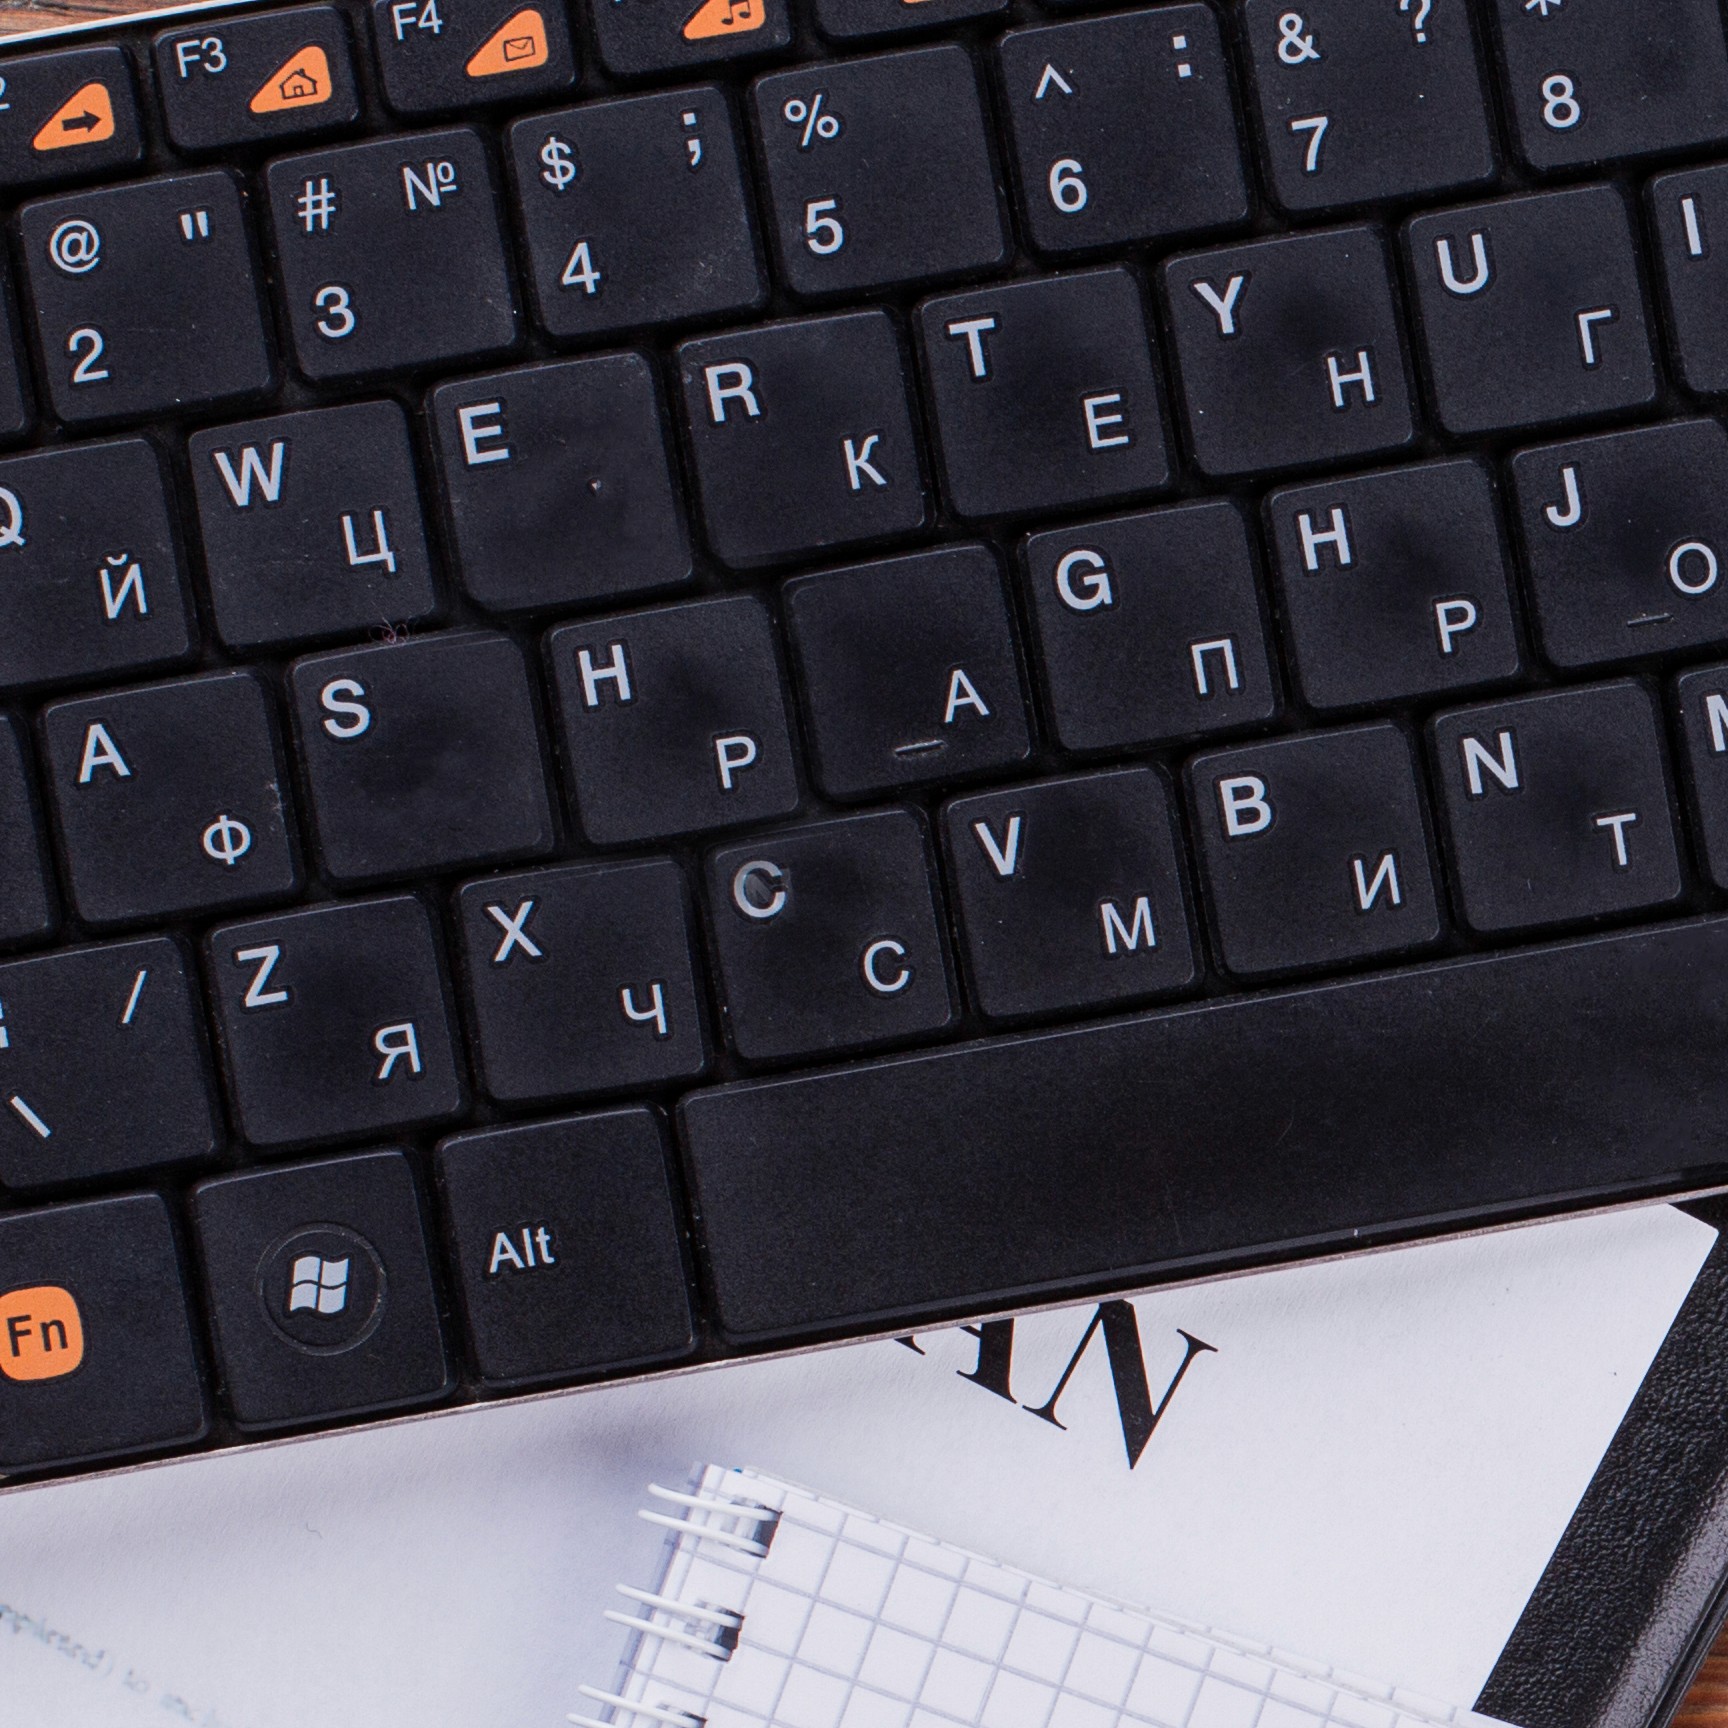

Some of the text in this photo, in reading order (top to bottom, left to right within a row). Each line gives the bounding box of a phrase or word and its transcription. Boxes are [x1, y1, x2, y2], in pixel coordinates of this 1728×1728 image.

[392, 0, 443, 41] F4
[1277, 12, 1321, 64] &
[164, 31, 227, 78] F3
[784, 94, 839, 147] %
[1542, 74, 1581, 128] 8
[541, 136, 576, 191] $
[1291, 116, 1329, 172] 7
[297, 178, 336, 232] #
[402, 161, 457, 210] №
[1049, 158, 1088, 213] 6
[49, 219, 100, 273] @
[805, 199, 843, 255] 5
[561, 241, 601, 294] 4
[1436, 233, 1489, 294] U
[315, 286, 355, 338] 3
[1193, 275, 1244, 334] Y
[68, 328, 109, 383] 2
[948, 317, 995, 377] T
[704, 362, 761, 422] R
[458, 402, 510, 465] E
[214, 442, 284, 507] W
[1546, 467, 1581, 527] J
[342, 510, 396, 573] Ц
[1298, 508, 1351, 571] H
[99, 553, 147, 619] Й
[1056, 549, 1113, 610] G
[578, 644, 631, 706] H
[1191, 638, 1239, 695] П
[321, 678, 370, 738] S
[79, 723, 131, 784] A
[1462, 731, 1519, 795] N
[1219, 775, 1272, 837] B
[202, 814, 251, 865] Ф
[974, 816, 1021, 876] V
[733, 860, 786, 918] C
[1353, 853, 1401, 910] И
[487, 900, 542, 962] X
[236, 944, 288, 1008] Z
[621, 983, 667, 1034] Ч
[374, 1022, 421, 1080] Я
[489, 1226, 555, 1274] Alt
[6, 1314, 68, 1357] Fn
